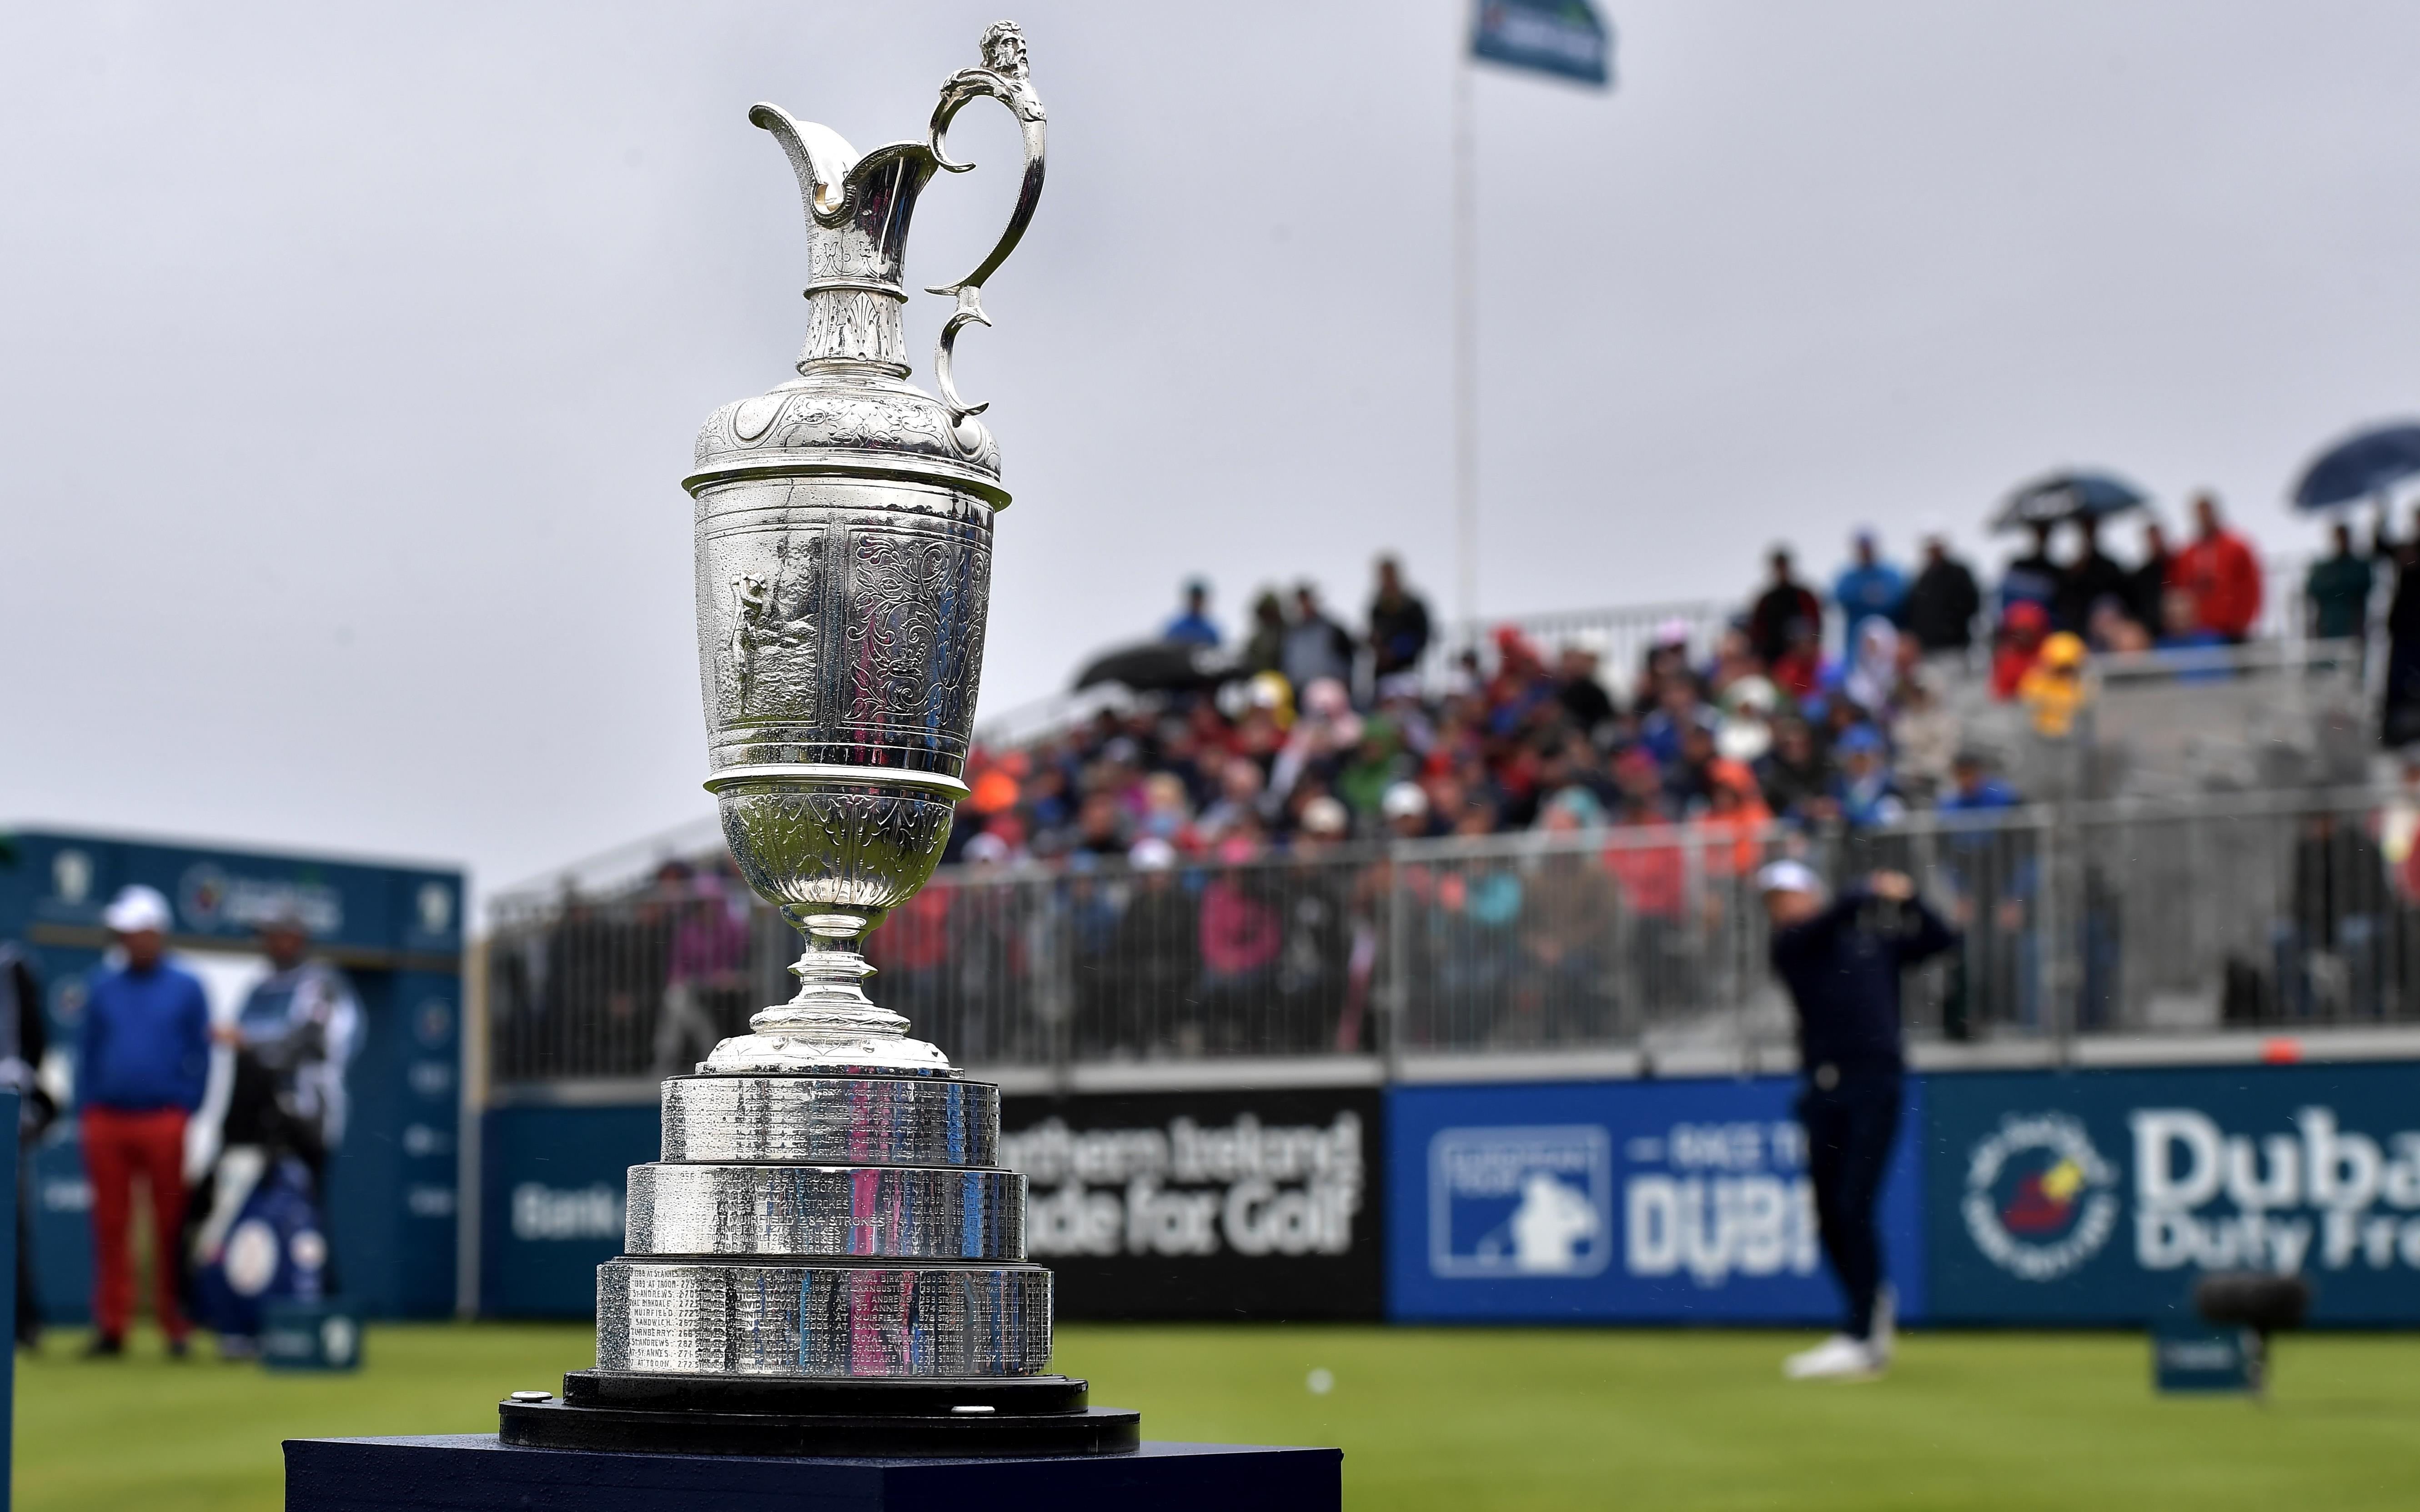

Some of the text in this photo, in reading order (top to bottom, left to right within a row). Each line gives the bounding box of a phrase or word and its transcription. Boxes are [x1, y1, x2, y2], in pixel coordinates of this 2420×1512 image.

[1171, 1111, 1360, 1183] Ireland
[799, 1184, 849, 1193] STROKES
[804, 1200, 849, 1209] STROKES
[829, 1216, 885, 1227] STROKES
[1125, 1178, 1222, 1257] for
[1222, 1177, 1361, 1257] Golf
[2133, 1209, 2312, 1280] Duty
[938, 1285, 964, 1293] STROKES
[854, 1334, 883, 1342] ROYAL
